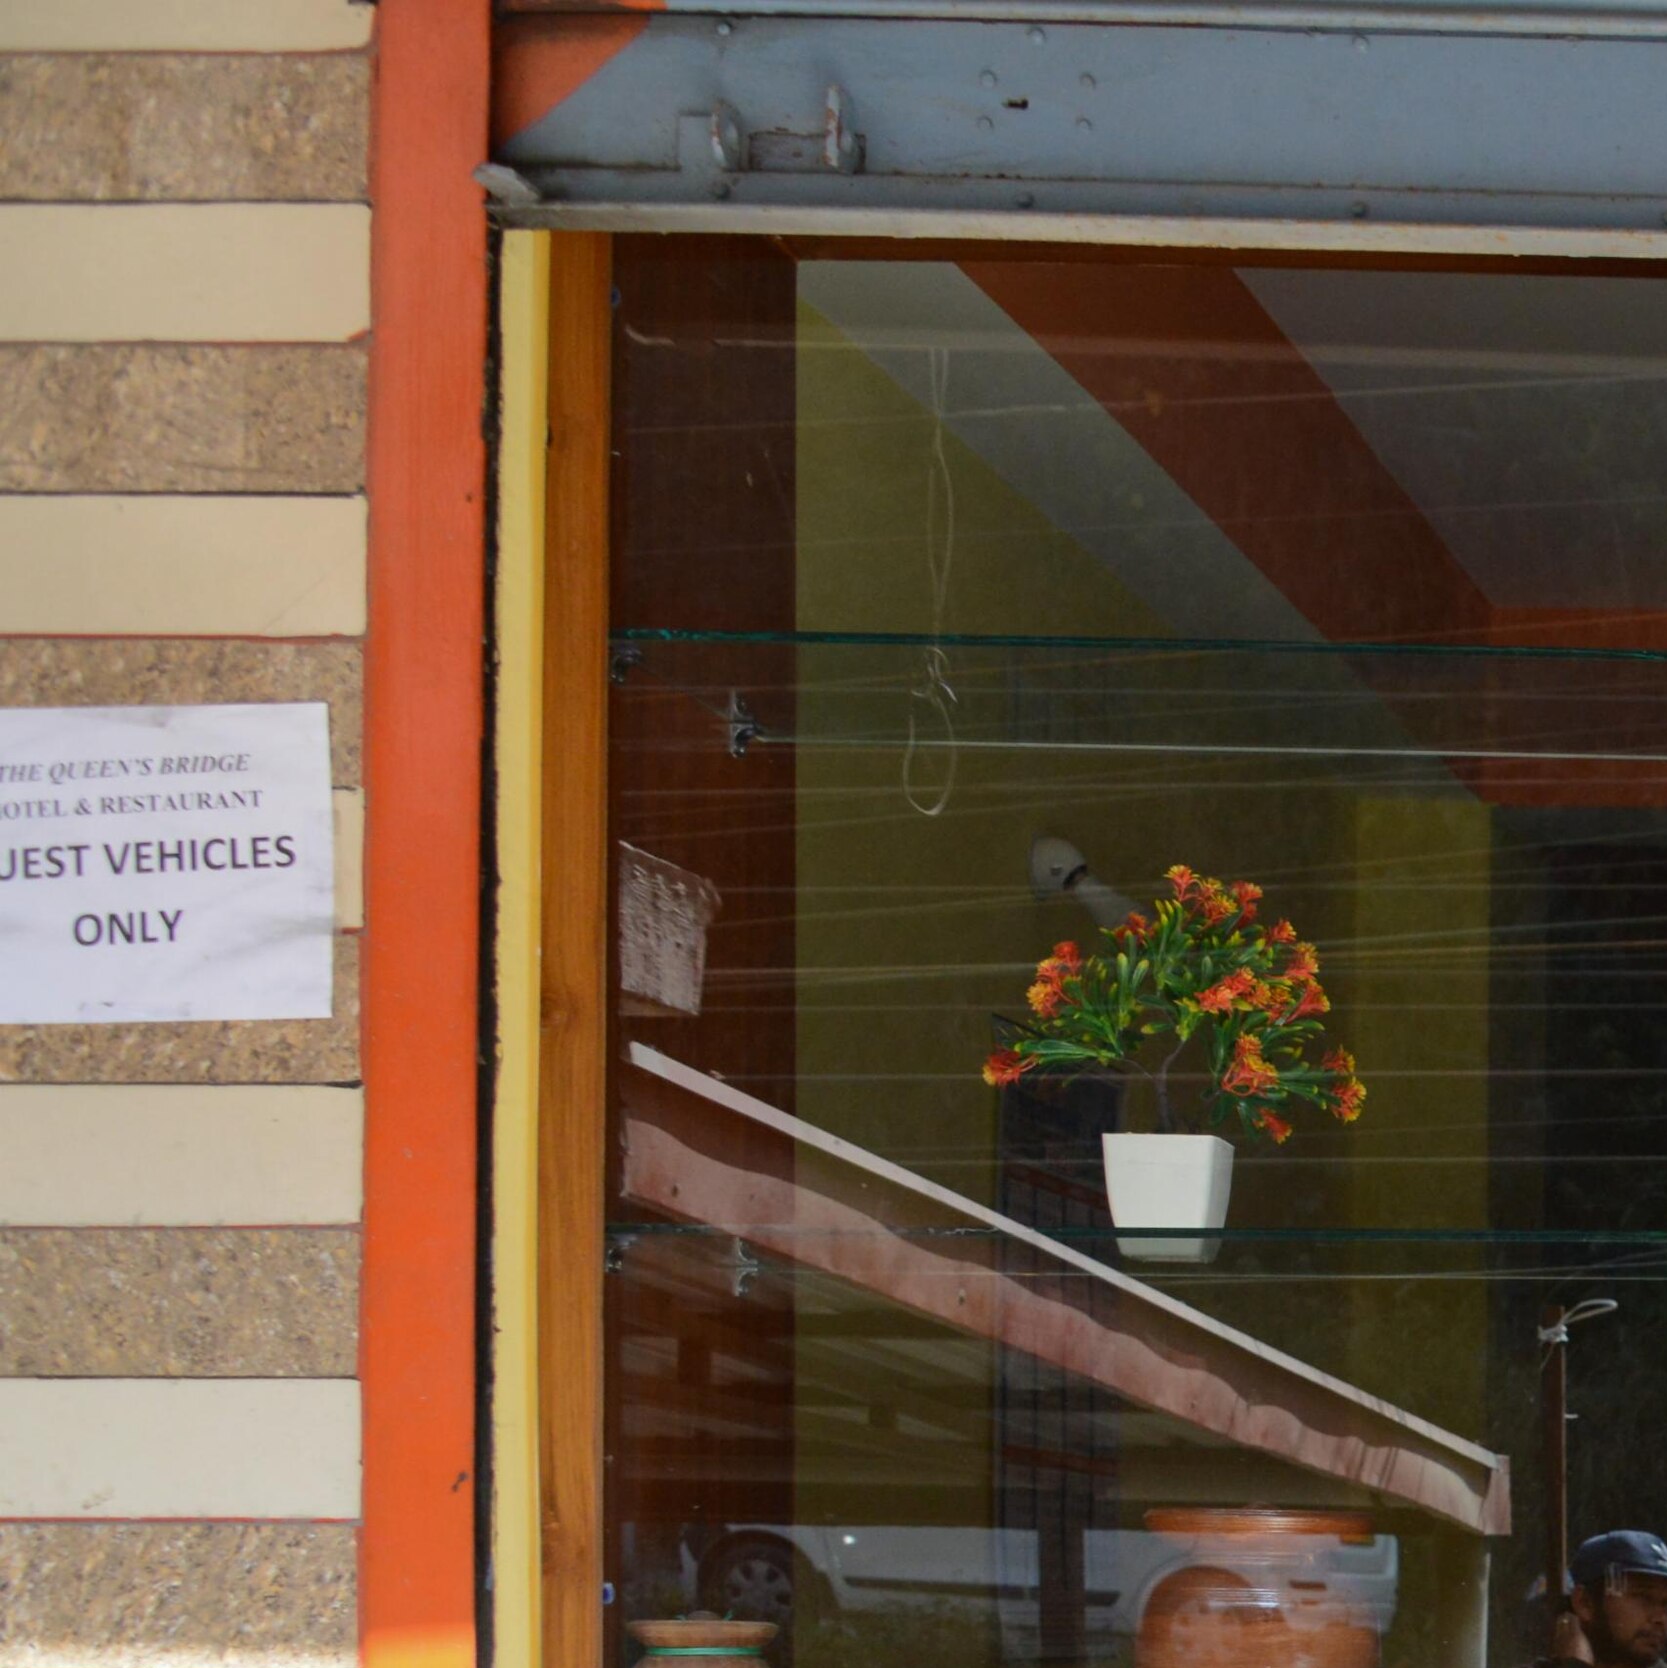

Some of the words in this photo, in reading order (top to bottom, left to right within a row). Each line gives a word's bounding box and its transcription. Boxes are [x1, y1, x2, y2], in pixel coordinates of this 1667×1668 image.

[48, 757, 154, 786] QUEEN'S
[159, 753, 252, 777] BRIDGE
[0, 798, 68, 822] OTEL
[73, 797, 93, 817] &
[99, 789, 264, 815] RESTAURANT
[0, 843, 91, 881] UEST
[103, 835, 297, 876] VEHICLES
[72, 909, 184, 947] ONLY
